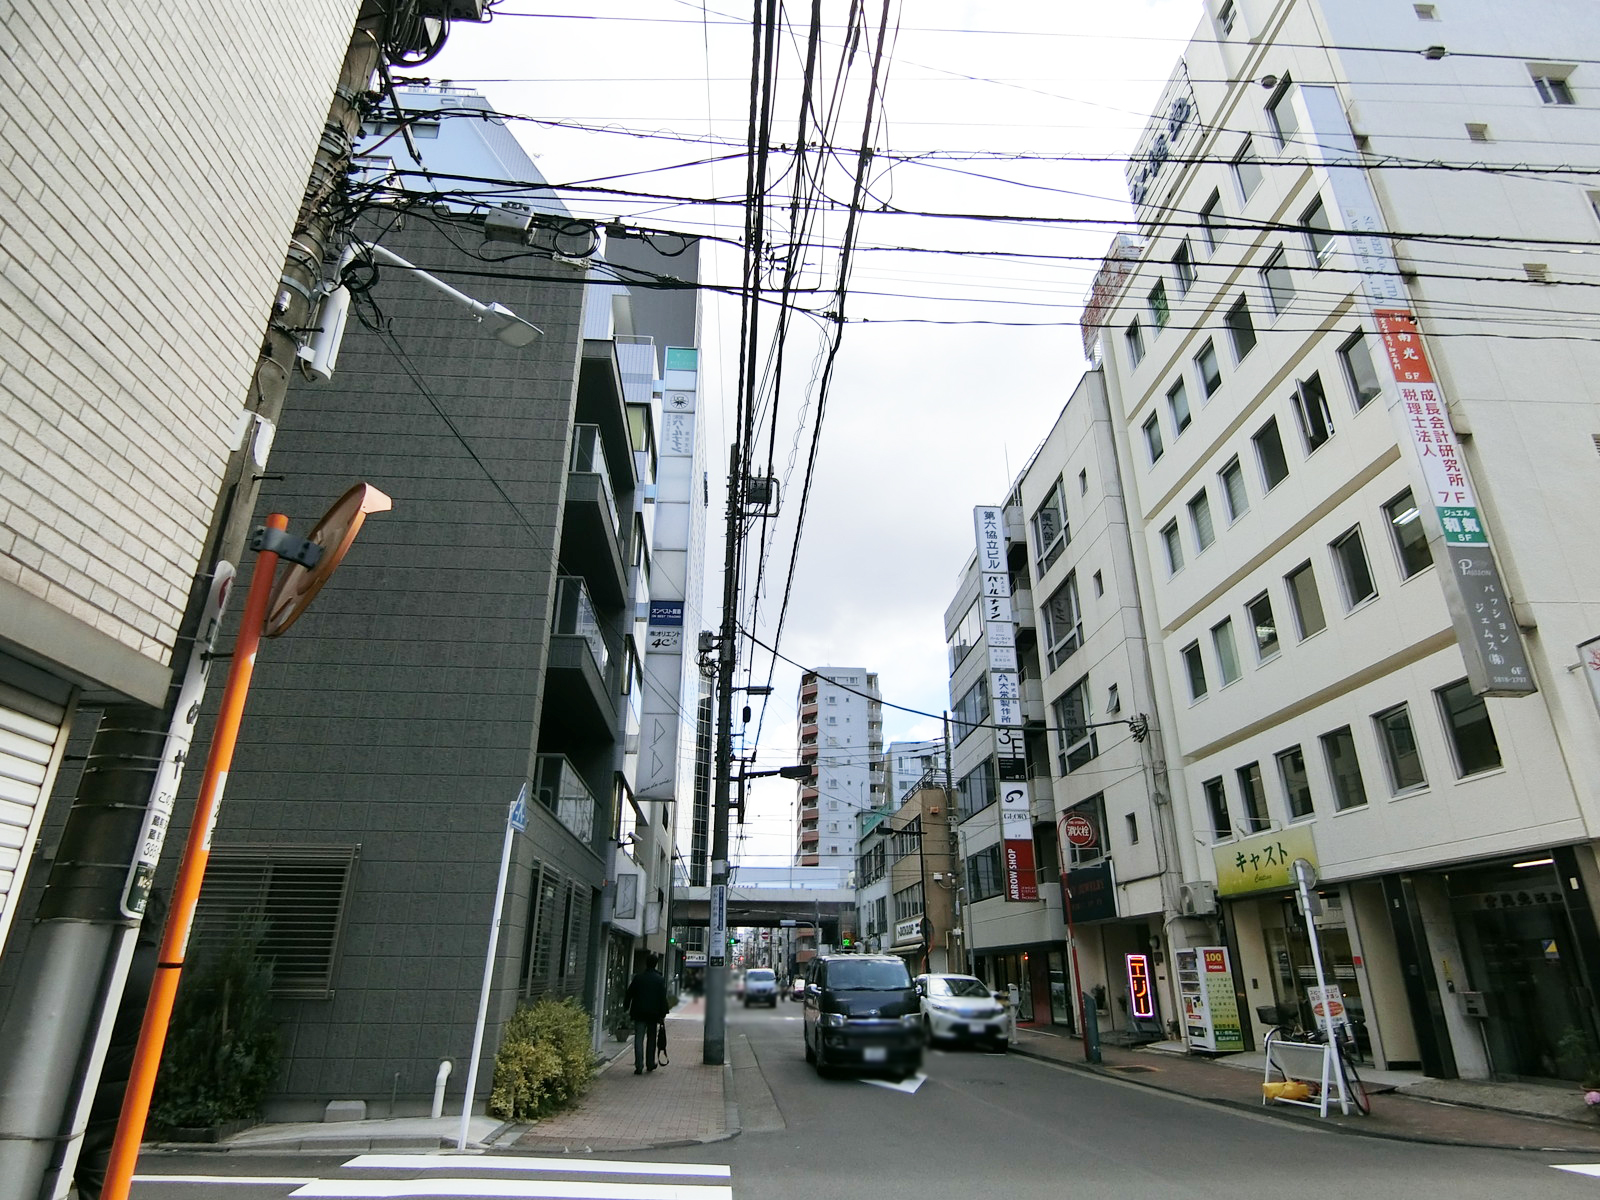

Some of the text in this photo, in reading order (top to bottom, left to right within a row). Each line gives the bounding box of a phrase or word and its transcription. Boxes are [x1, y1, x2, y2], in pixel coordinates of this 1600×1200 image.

[1402, 388, 1437, 457] 税理士法人
[1420, 388, 1465, 488] 成長会計研究所
[1443, 509, 1471, 517] ジュエル
[983, 511, 1001, 570] 第六協立ビル
[1458, 533, 1473, 542] 5F
[1510, 666, 1522, 675] 6F
[998, 682, 1012, 724] 大栄製作所
[1066, 826, 1089, 837] 消火栓
[1007, 848, 1018, 869] SHOP
[1235, 841, 1288, 873] キャスト
[1009, 870, 1020, 900] ARROW
[1205, 953, 1222, 962] 100
